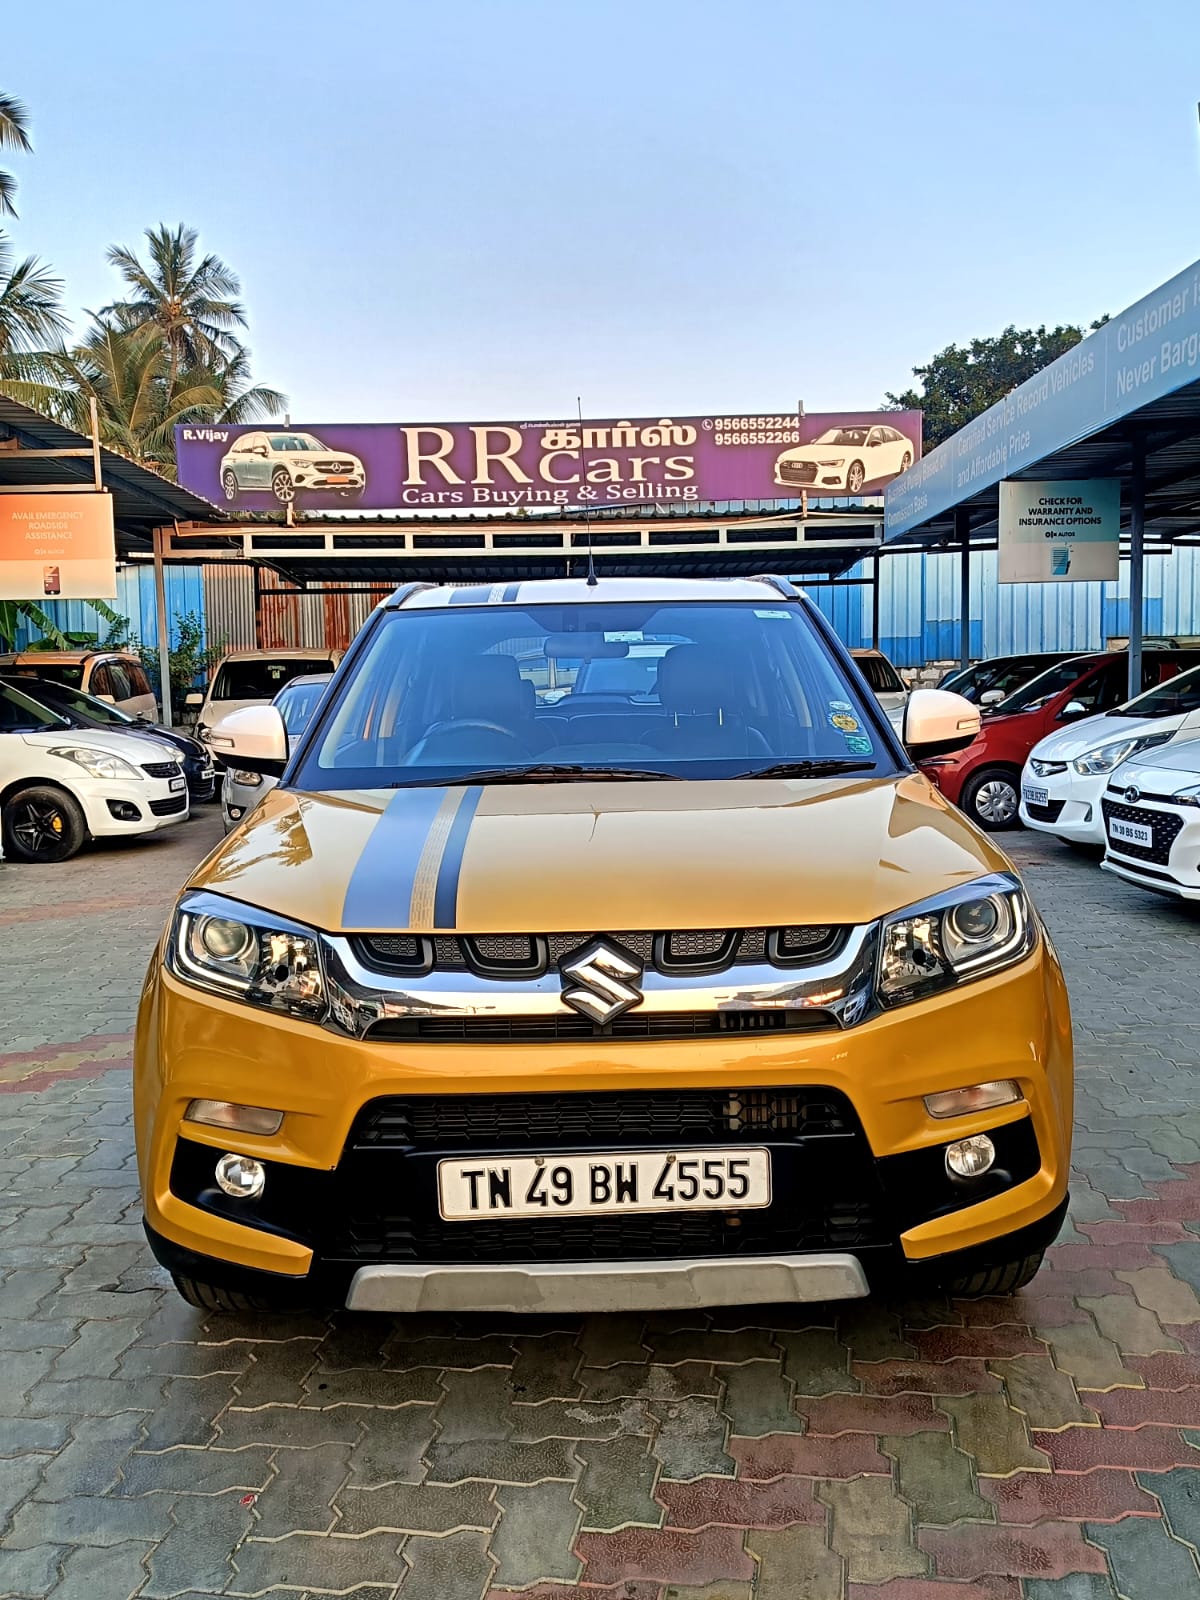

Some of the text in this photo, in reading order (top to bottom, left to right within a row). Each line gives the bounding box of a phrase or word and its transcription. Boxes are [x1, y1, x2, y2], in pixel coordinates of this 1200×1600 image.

[1117, 274, 1200, 353] Customer i
[1116, 332, 1200, 398] Never Barg
[987, 402, 1015, 437] Service
[1017, 376, 1049, 417] Record
[1051, 351, 1094, 394] Vehicles
[714, 416, 800, 430] 9566552244
[183, 429, 229, 442] R.Vijay
[540, 418, 698, 450] கார்ஸ்
[714, 431, 800, 446] 9566552266
[400, 426, 695, 485] RR Cars
[957, 430, 1030, 488] and Affordable Price
[402, 482, 699, 506] Cars Buying & Selling
[1039, 497, 1083, 506] CHECK FOR
[12, 511, 84, 520] AVAIL EMERGENCY
[1028, 507, 1093, 516] WARRANTY AND
[28, 521, 68, 530] ROADSIDE
[1018, 517, 1102, 526] INSURANCE OPTIONS
[25, 531, 72, 539] ASSISTANCE
[1112, 823, 1119, 833] TN
[1126, 827, 1133, 838] BS
[1134, 829, 1148, 841] 5323
[461, 1157, 750, 1210] TN 49 BW 4555
